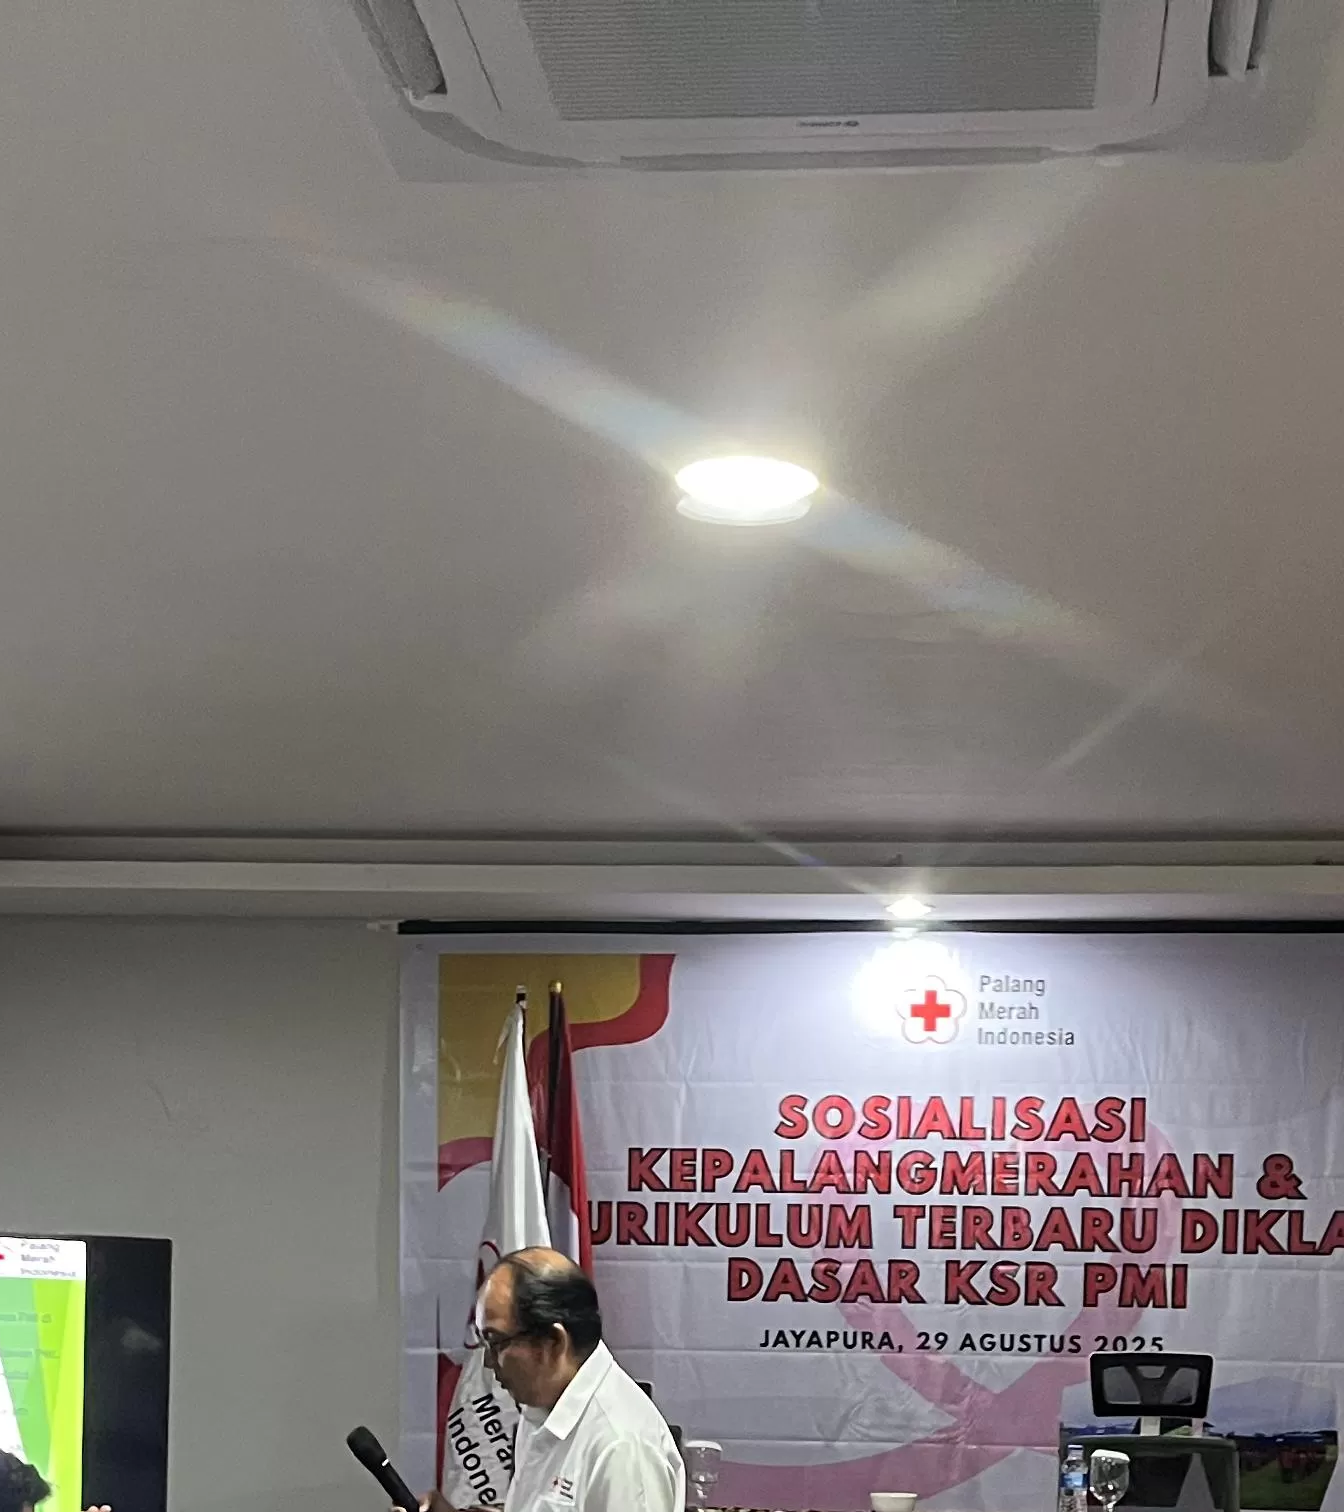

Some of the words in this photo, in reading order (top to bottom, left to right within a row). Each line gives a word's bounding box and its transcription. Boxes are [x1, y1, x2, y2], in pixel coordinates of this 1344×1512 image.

[977, 1002, 1040, 1020] Merah
[978, 974, 1047, 997] Palang
[977, 1027, 1075, 1046] Indonesia
[774, 1094, 1147, 1143] SOSIALISASI
[627, 1147, 1234, 1200] KEPALANGMERAHAN
[1256, 1153, 1308, 1201] &
[587, 1199, 873, 1250] URIKULUM
[893, 1203, 1158, 1254] TERBARU
[726, 1256, 926, 1305] DASAR
[944, 1259, 1066, 1307] KSR
[1082, 1262, 1189, 1309] PMI
[759, 1329, 904, 1353] JAYAPURA,
[916, 1331, 949, 1352] 29
[959, 1332, 1082, 1354] AGUSTUS
[1094, 1335, 1164, 1352] 2025
[447, 1406, 497, 1505] Indone
[472, 1392, 514, 1471] Mera
